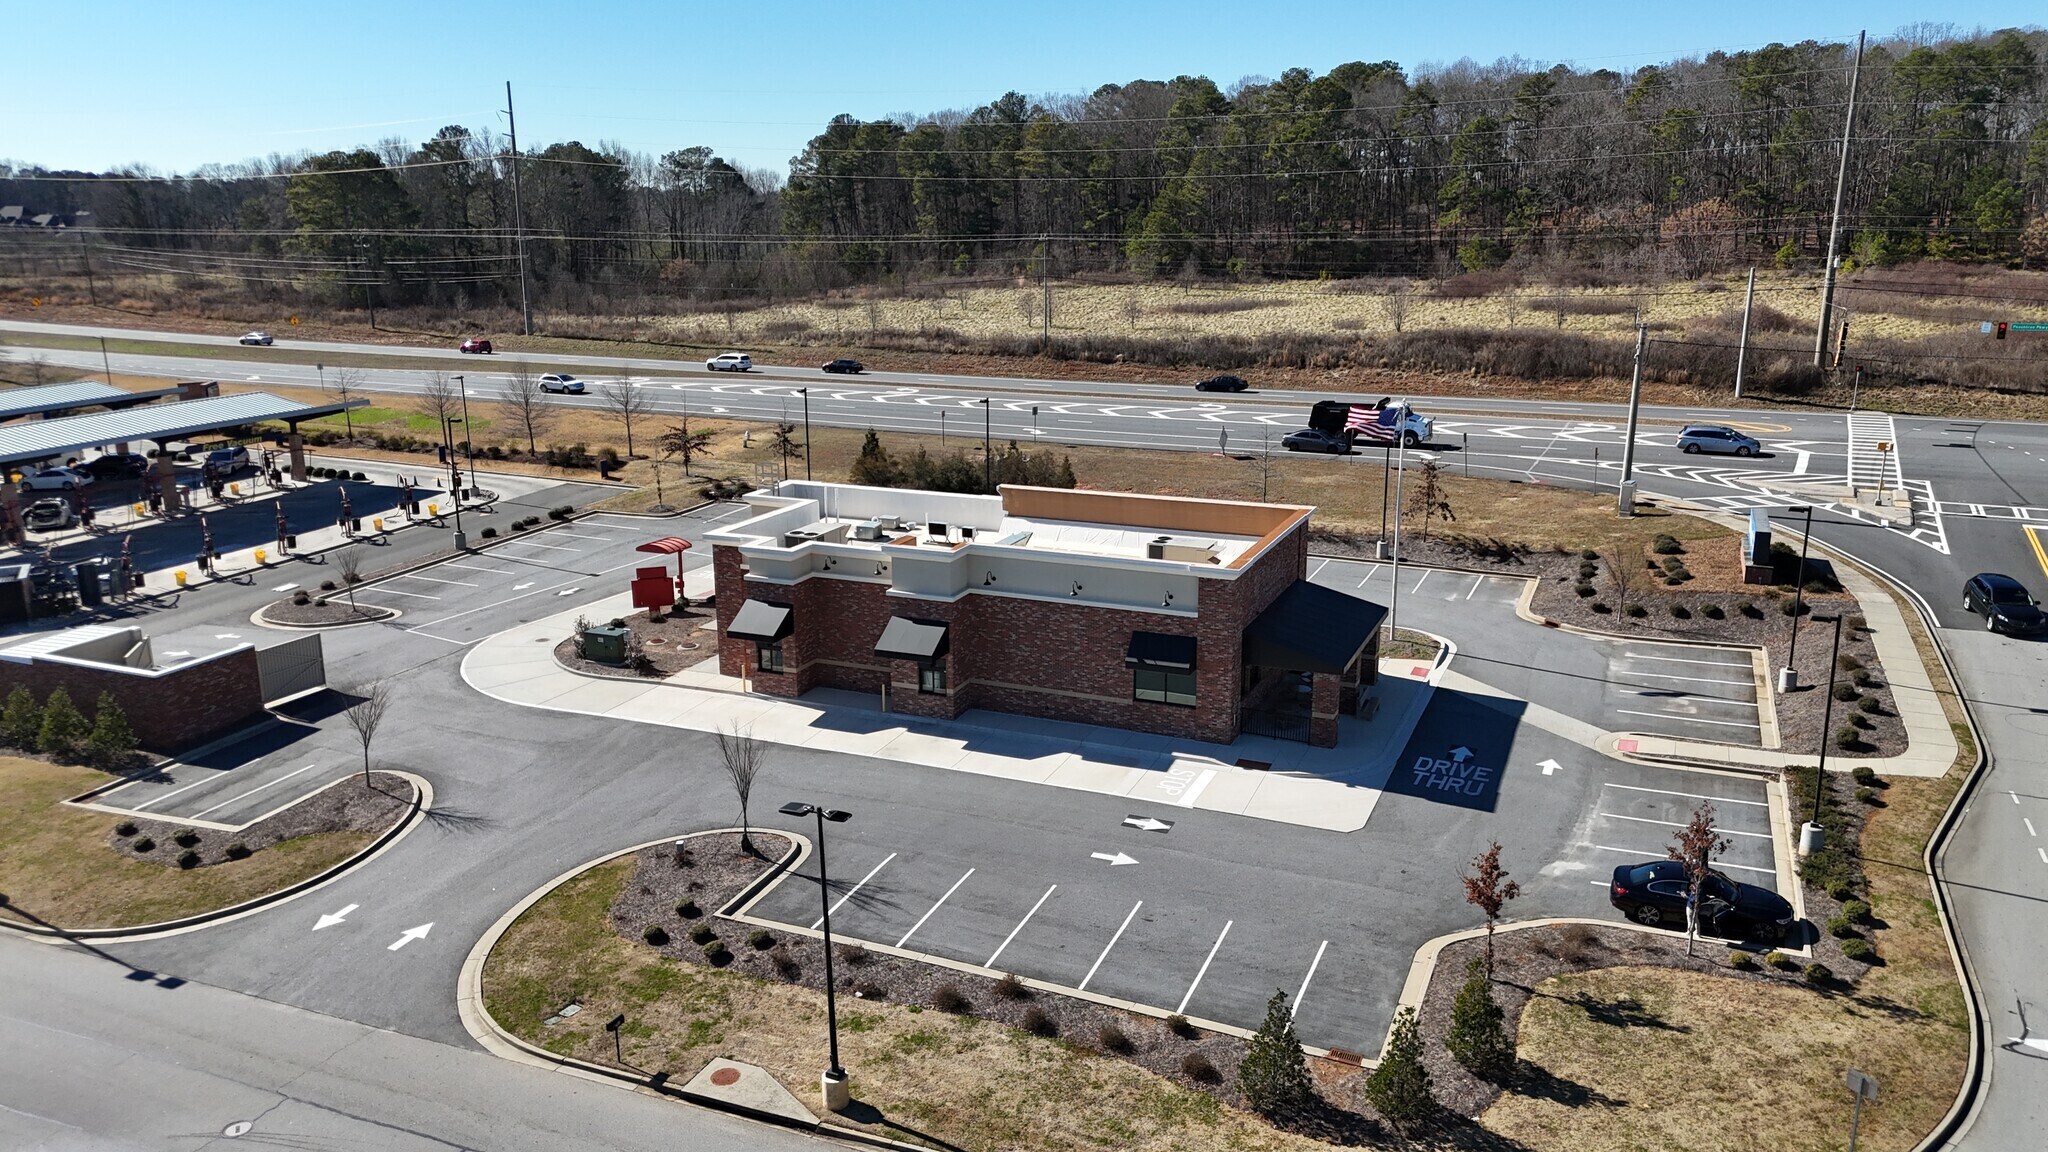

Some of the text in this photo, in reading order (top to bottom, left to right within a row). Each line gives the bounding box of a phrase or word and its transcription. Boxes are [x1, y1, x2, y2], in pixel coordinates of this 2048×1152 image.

[203, 436, 262, 451] Free Vacuum
[1413, 756, 1493, 782] DRIVE
[1156, 769, 1195, 796] STOP
[1413, 770, 1485, 795] THRU
